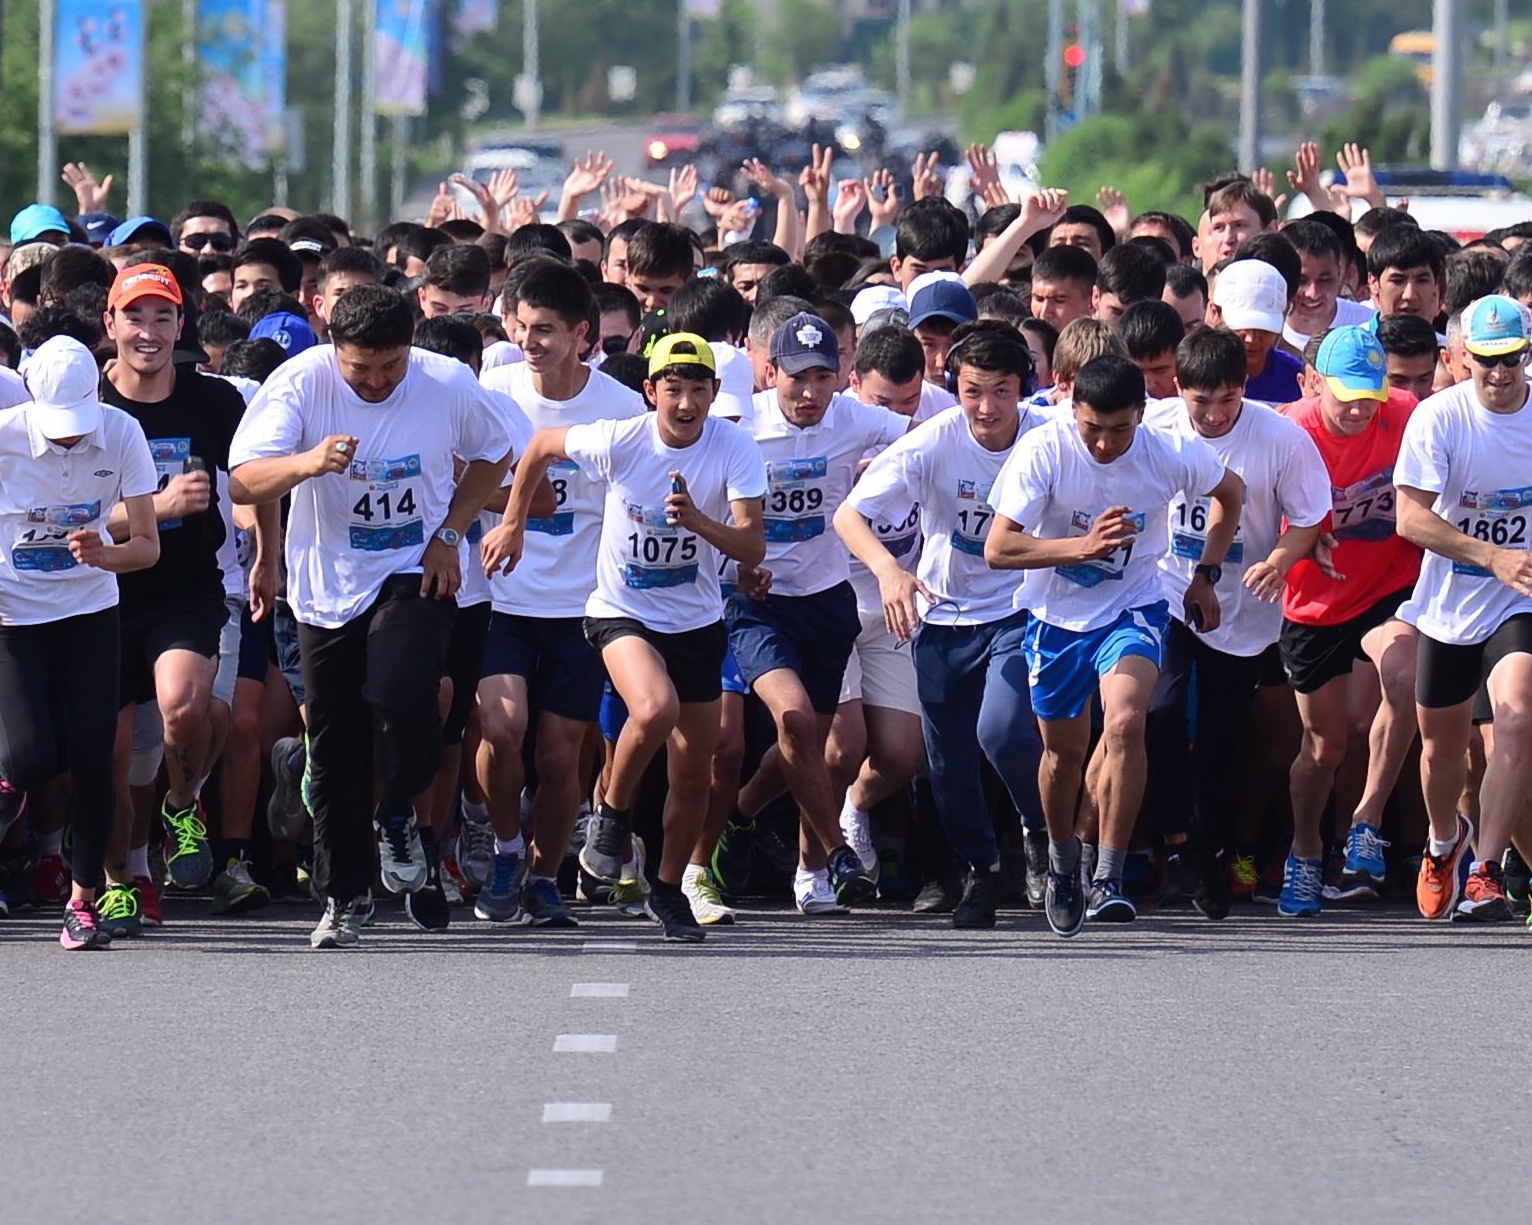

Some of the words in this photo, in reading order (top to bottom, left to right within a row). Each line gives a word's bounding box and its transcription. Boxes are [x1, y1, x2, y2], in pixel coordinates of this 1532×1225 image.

[352, 487, 417, 522] 414
[957, 509, 995, 536] 17
[1457, 515, 1527, 546] 1862
[628, 532, 698, 564] 1075
